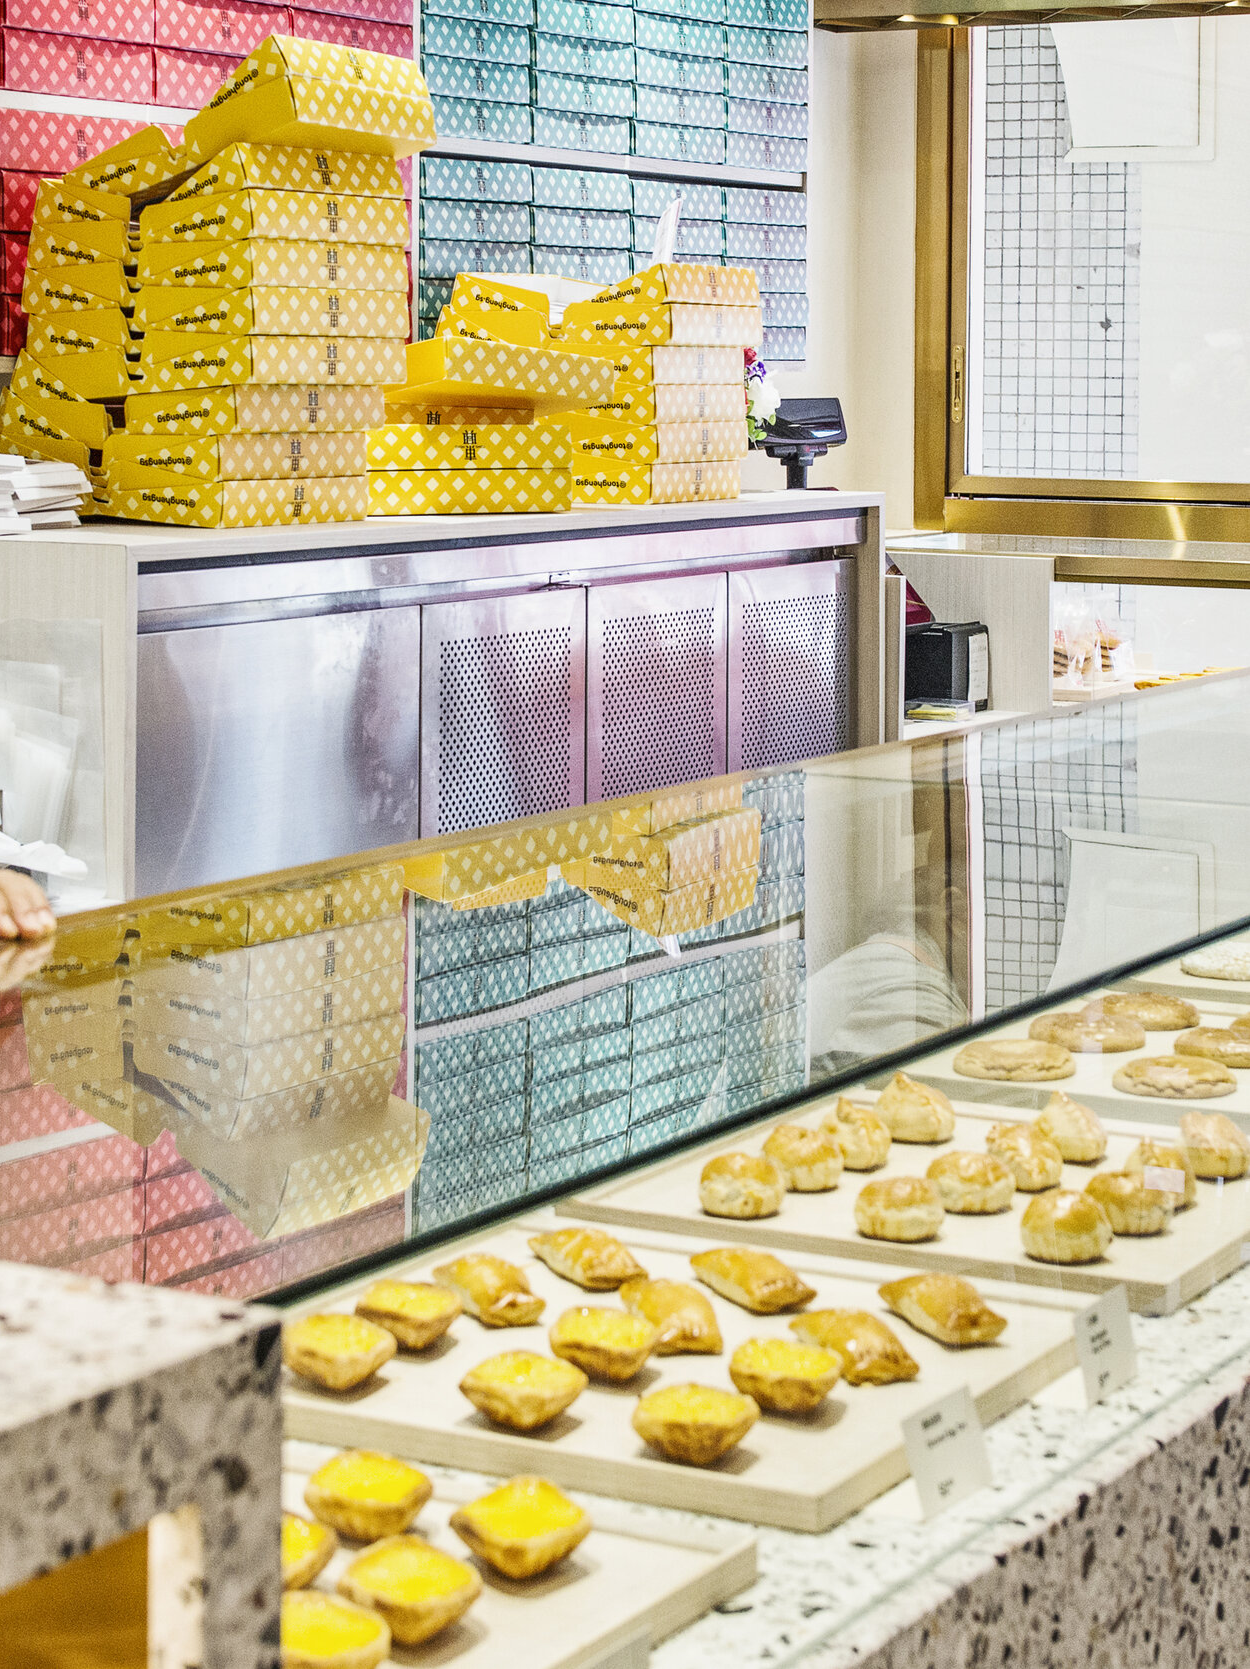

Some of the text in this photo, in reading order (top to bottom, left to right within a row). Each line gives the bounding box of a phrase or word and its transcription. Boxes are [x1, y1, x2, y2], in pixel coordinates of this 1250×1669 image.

[89, 164, 137, 188] tongheng.sg
[174, 215, 226, 234] @tonghengsg
[50, 245, 95, 262] tongheng.sg
[174, 263, 226, 278] @tonghengsg
[45, 289, 89, 305] tongheng.sg
[175, 310, 227, 326] @tonghengsg
[595, 322, 646, 331] @tonghengsg
[50, 335, 94, 350] tongheng.sg
[173, 358, 226, 369] @tonghengsg
[157, 408, 210, 423] @tonghengsg
[582, 441, 633, 451] @tonghengsg
[139, 456, 193, 467] @tonghengsg
[576, 478, 626, 488] @tonghengsg
[142, 492, 196, 508] @tonghengsg
